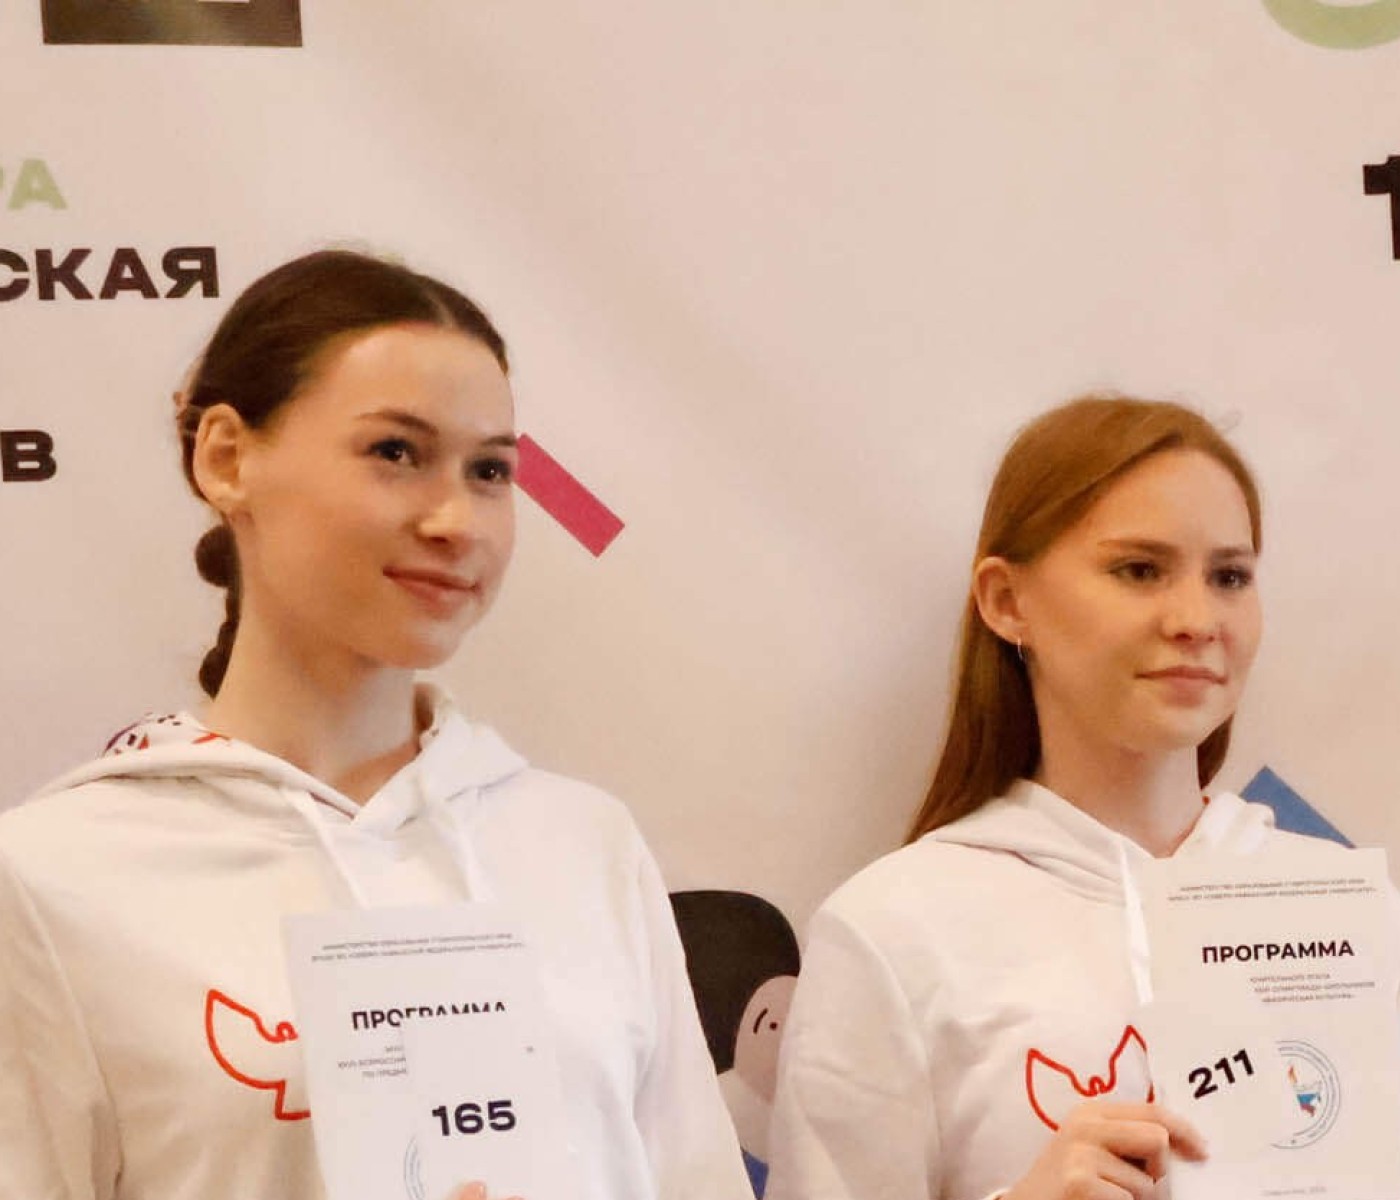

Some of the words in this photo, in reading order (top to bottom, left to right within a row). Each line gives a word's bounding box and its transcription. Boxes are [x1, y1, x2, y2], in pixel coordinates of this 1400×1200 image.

[0, 159, 67, 209] А
[1202, 940, 1355, 963] ПРОГРАММА
[1188, 1048, 1255, 1100] 211
[432, 1099, 517, 1137] 165
